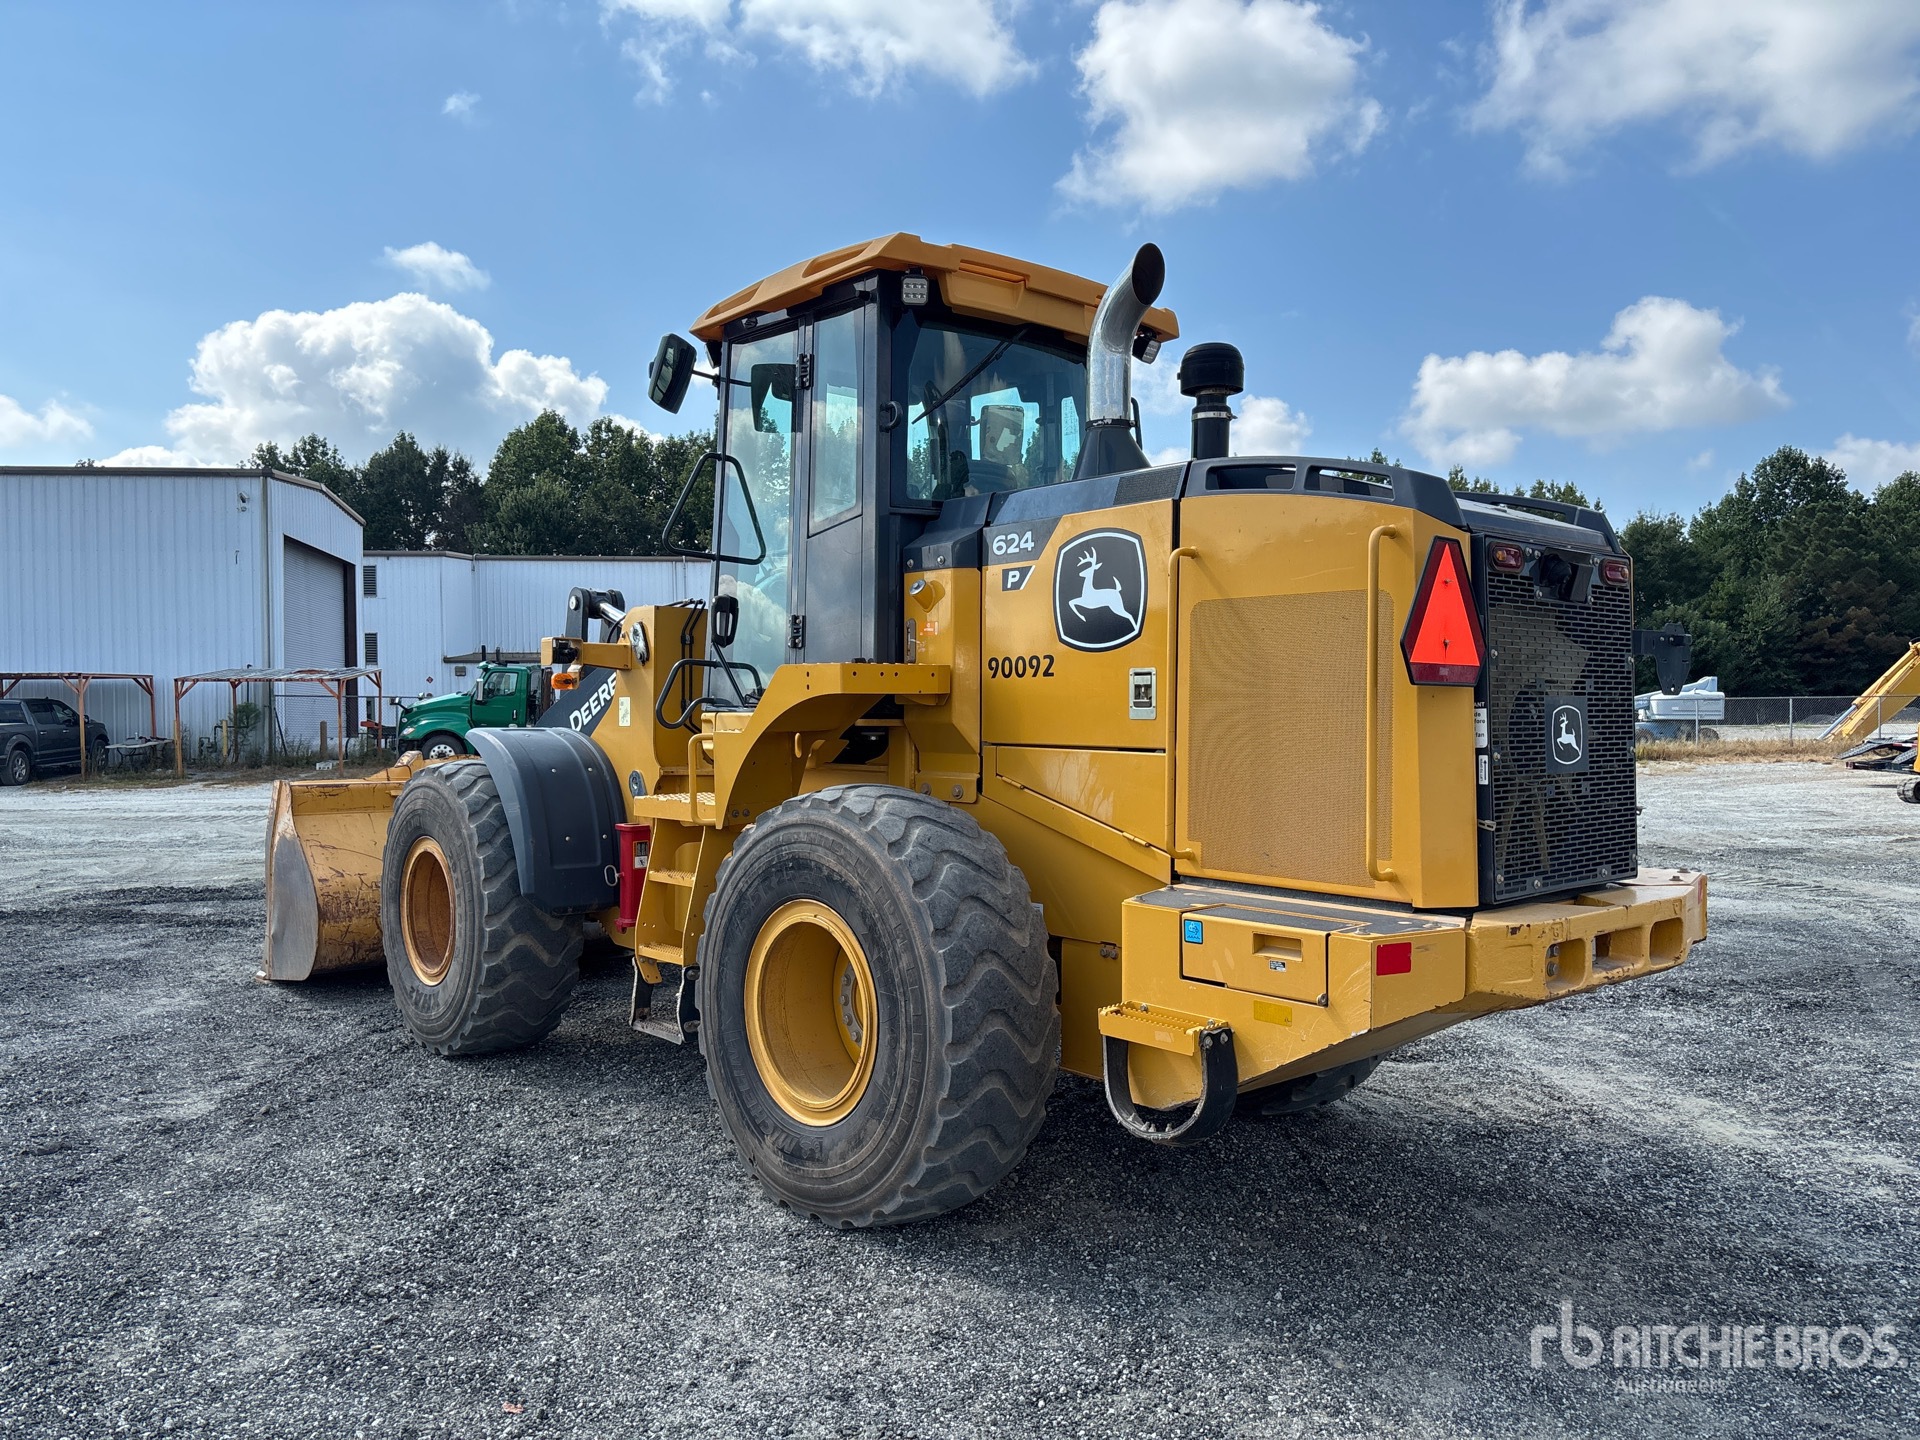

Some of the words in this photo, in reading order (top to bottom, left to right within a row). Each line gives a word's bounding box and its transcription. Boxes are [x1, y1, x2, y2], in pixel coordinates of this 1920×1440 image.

[992, 531, 1035, 556] 624
[1007, 570, 1020, 589] P
[987, 654, 1055, 679] 90092
[569, 671, 618, 732] DEERE
